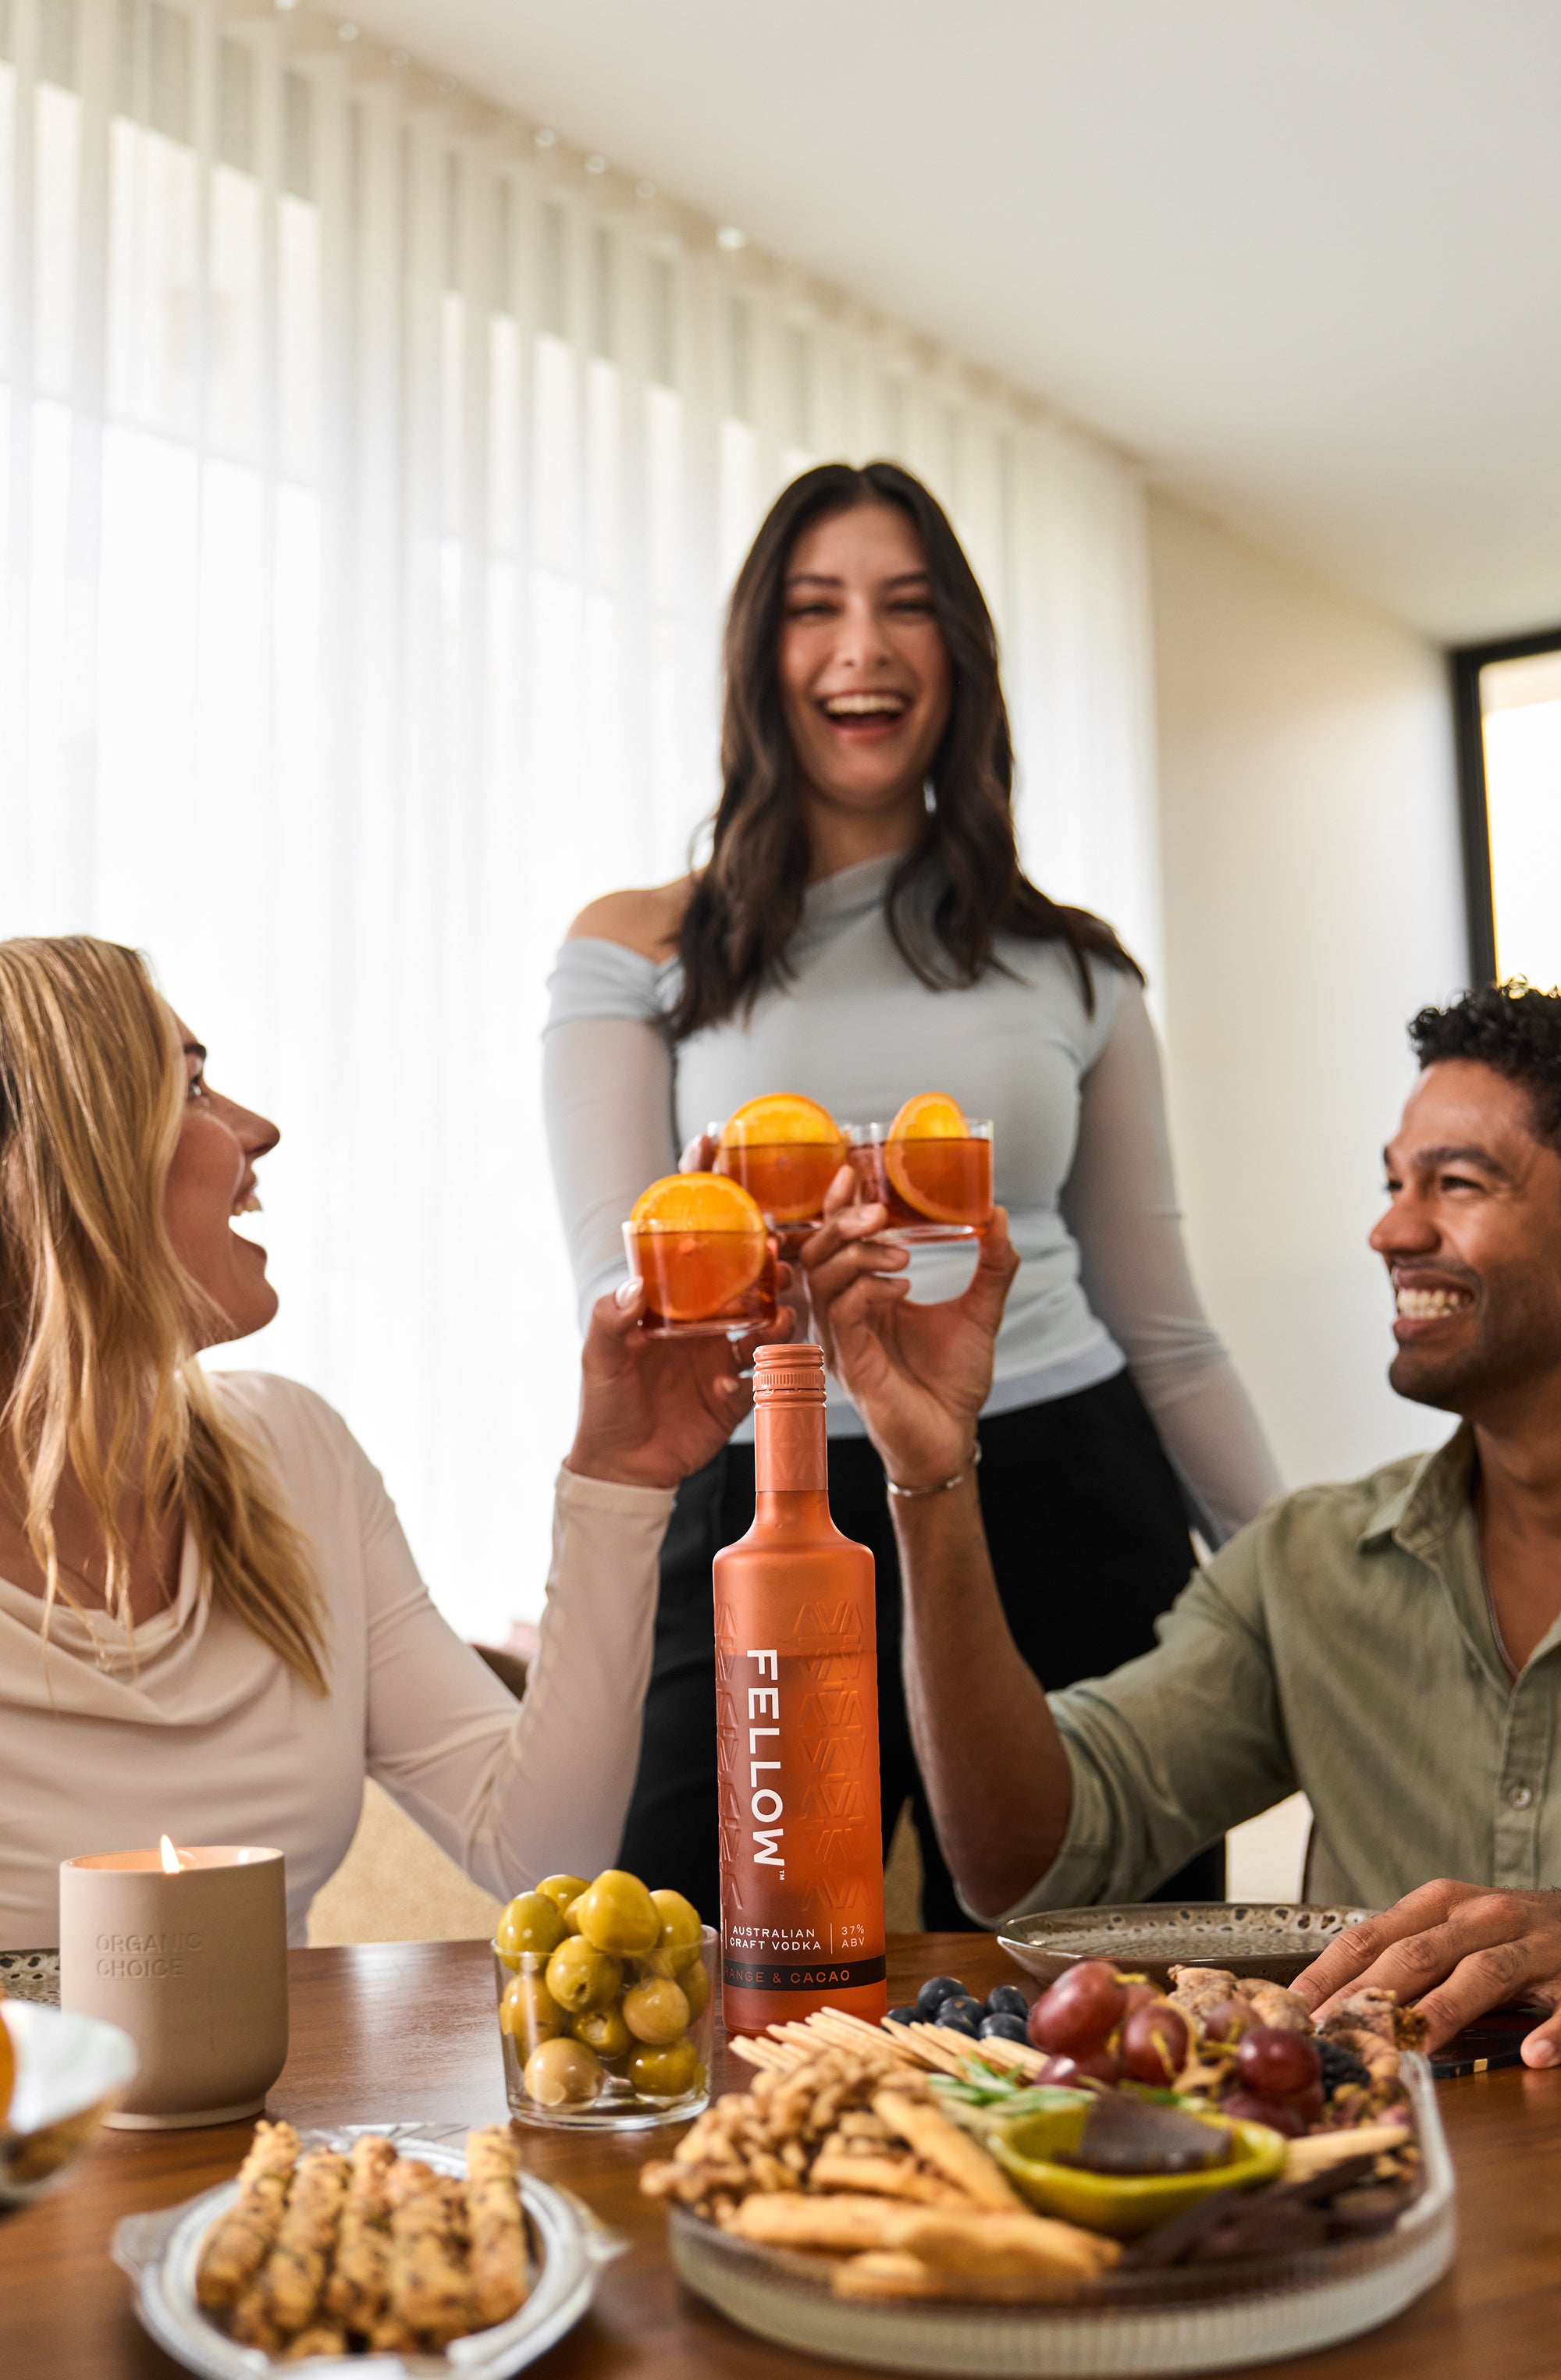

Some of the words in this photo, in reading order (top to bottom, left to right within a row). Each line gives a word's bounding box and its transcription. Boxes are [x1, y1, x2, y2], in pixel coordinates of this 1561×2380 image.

[746, 1649, 785, 1867] FELLOW
[732, 1925, 816, 1938] AUSTRALIAN
[841, 1924, 865, 1936] 37%
[96, 1932, 203, 1953] ORGANIC
[730, 1937, 766, 1950] CRAFT
[771, 1941, 822, 1951] VODKA
[841, 1937, 865, 1948] ABV
[96, 1958, 187, 1979] CHOICE
[724, 1966, 765, 1983] RANGE
[772, 1971, 781, 1984] &
[790, 1969, 851, 1984] CACAO
